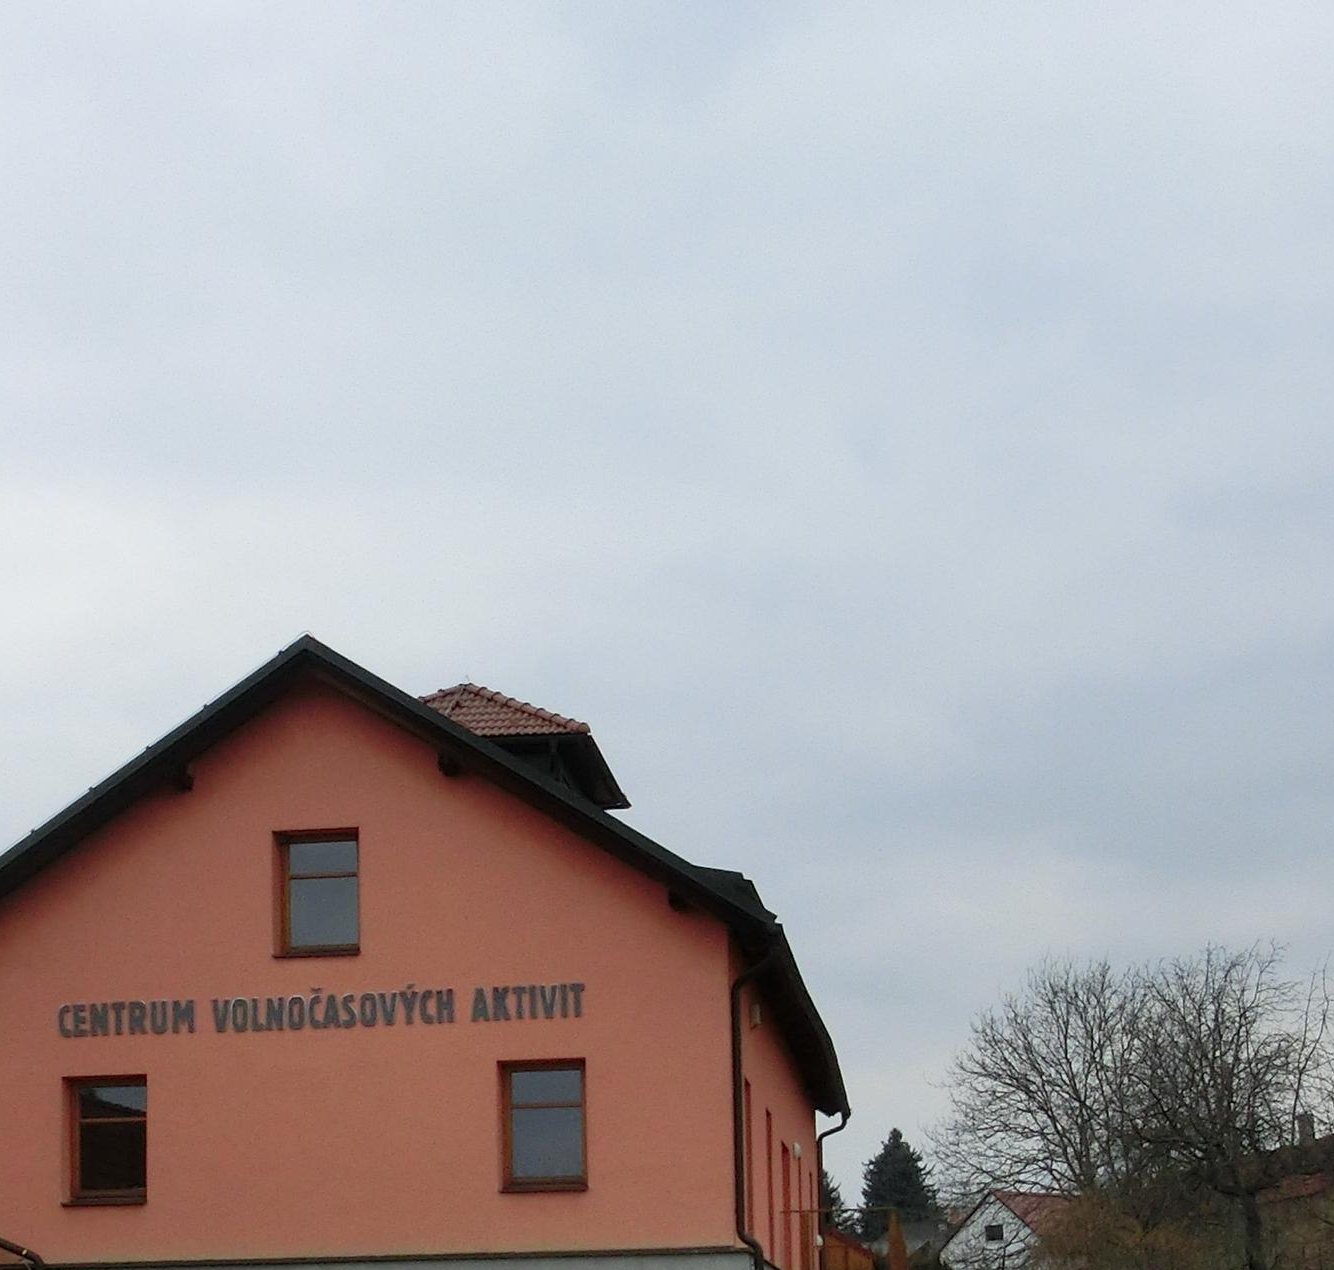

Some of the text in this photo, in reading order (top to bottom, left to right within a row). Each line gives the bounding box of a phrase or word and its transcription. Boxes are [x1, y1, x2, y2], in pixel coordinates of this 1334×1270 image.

[58, 982, 586, 1038] CENTRUM VOLNOČASOVÝCH AKTIVIT
